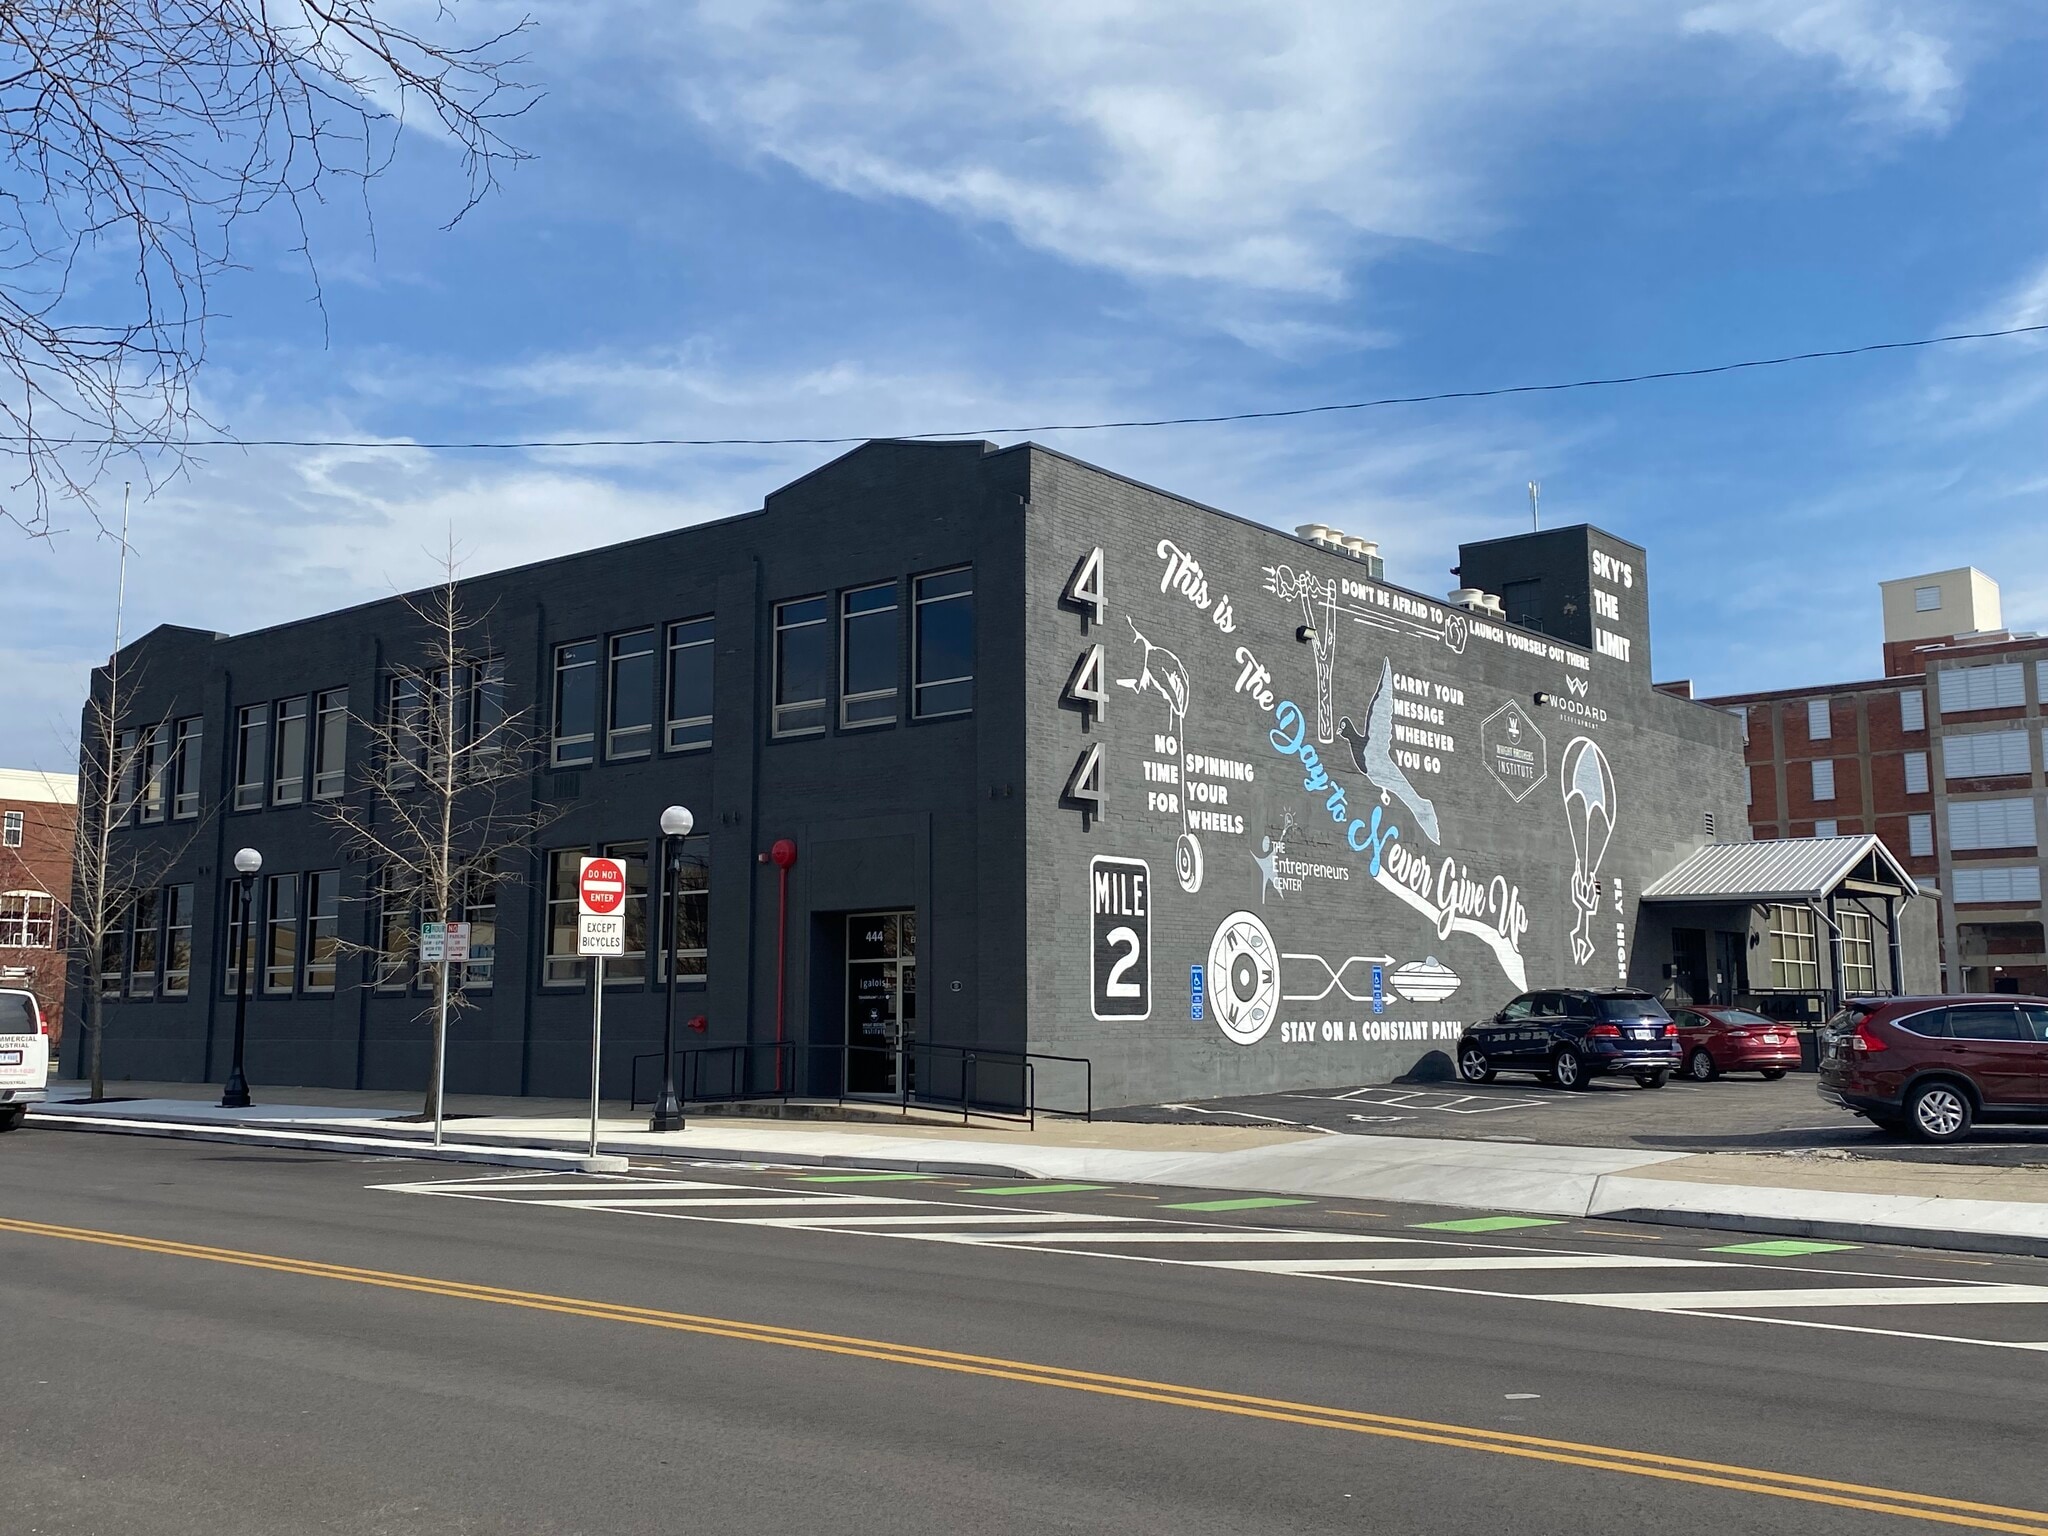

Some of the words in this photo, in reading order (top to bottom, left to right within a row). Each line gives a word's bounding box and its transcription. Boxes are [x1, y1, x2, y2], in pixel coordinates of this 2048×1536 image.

[1592, 549, 1633, 588] SKY'S
[1157, 539, 1211, 609] This
[1213, 594, 1236, 633] is
[1341, 578, 1375, 603] DON'T
[1377, 589, 1390, 608] BE
[1392, 595, 1428, 619] AFRAID
[1430, 606, 1443, 624] TO
[1593, 588, 1619, 621] THE
[1469, 619, 1504, 644] LAUNCH
[1505, 631, 1548, 657] YOURSELF
[1549, 646, 1565, 663] OUT
[1566, 650, 1590, 671] THERE
[1595, 627, 1630, 663] LIMIT
[1235, 647, 1274, 711] The
[1393, 673, 1430, 698] CARRY
[1434, 684, 1464, 706] YOUR
[1393, 698, 1445, 726] MESSAGE
[1549, 694, 1607, 722] WOODARD
[1154, 734, 1178, 755] NO
[1394, 724, 1455, 752] WHEREVER
[1143, 761, 1179, 784] TIME
[1186, 753, 1254, 782] SPINNING
[1396, 750, 1421, 770] YOU
[1423, 755, 1441, 774] GO
[1497, 760, 1534, 778] INSTITUTE
[1148, 791, 1179, 813] FOR
[1186, 781, 1228, 805] YOUR
[1187, 809, 1244, 834] WHEELS
[1271, 841, 1285, 854] THE
[588, 869, 599, 879] DO
[602, 870, 617, 880] NOT
[1272, 856, 1349, 880] Entrepreneurs
[1095, 871, 1144, 916] MILE
[1273, 877, 1302, 891] CENTER
[1613, 878, 1624, 915] FLY
[590, 893, 614, 903] ENTER
[1437, 857, 1486, 940] Give
[1489, 875, 1528, 952] Up
[424, 925, 430, 933] 2
[448, 924, 458, 933] NO
[587, 922, 616, 933] EXCEPT
[865, 930, 883, 942] 444
[582, 936, 620, 948] BICYCLES
[1616, 923, 1627, 979] HIGH
[1106, 926, 1140, 997] 2
[1280, 1021, 1316, 1042] STAY
[1322, 1020, 1344, 1041] ON
[1348, 1021, 1358, 1041] A
[1362, 1020, 1428, 1041] CONSTANT
[1432, 1021, 1462, 1041] PATH
